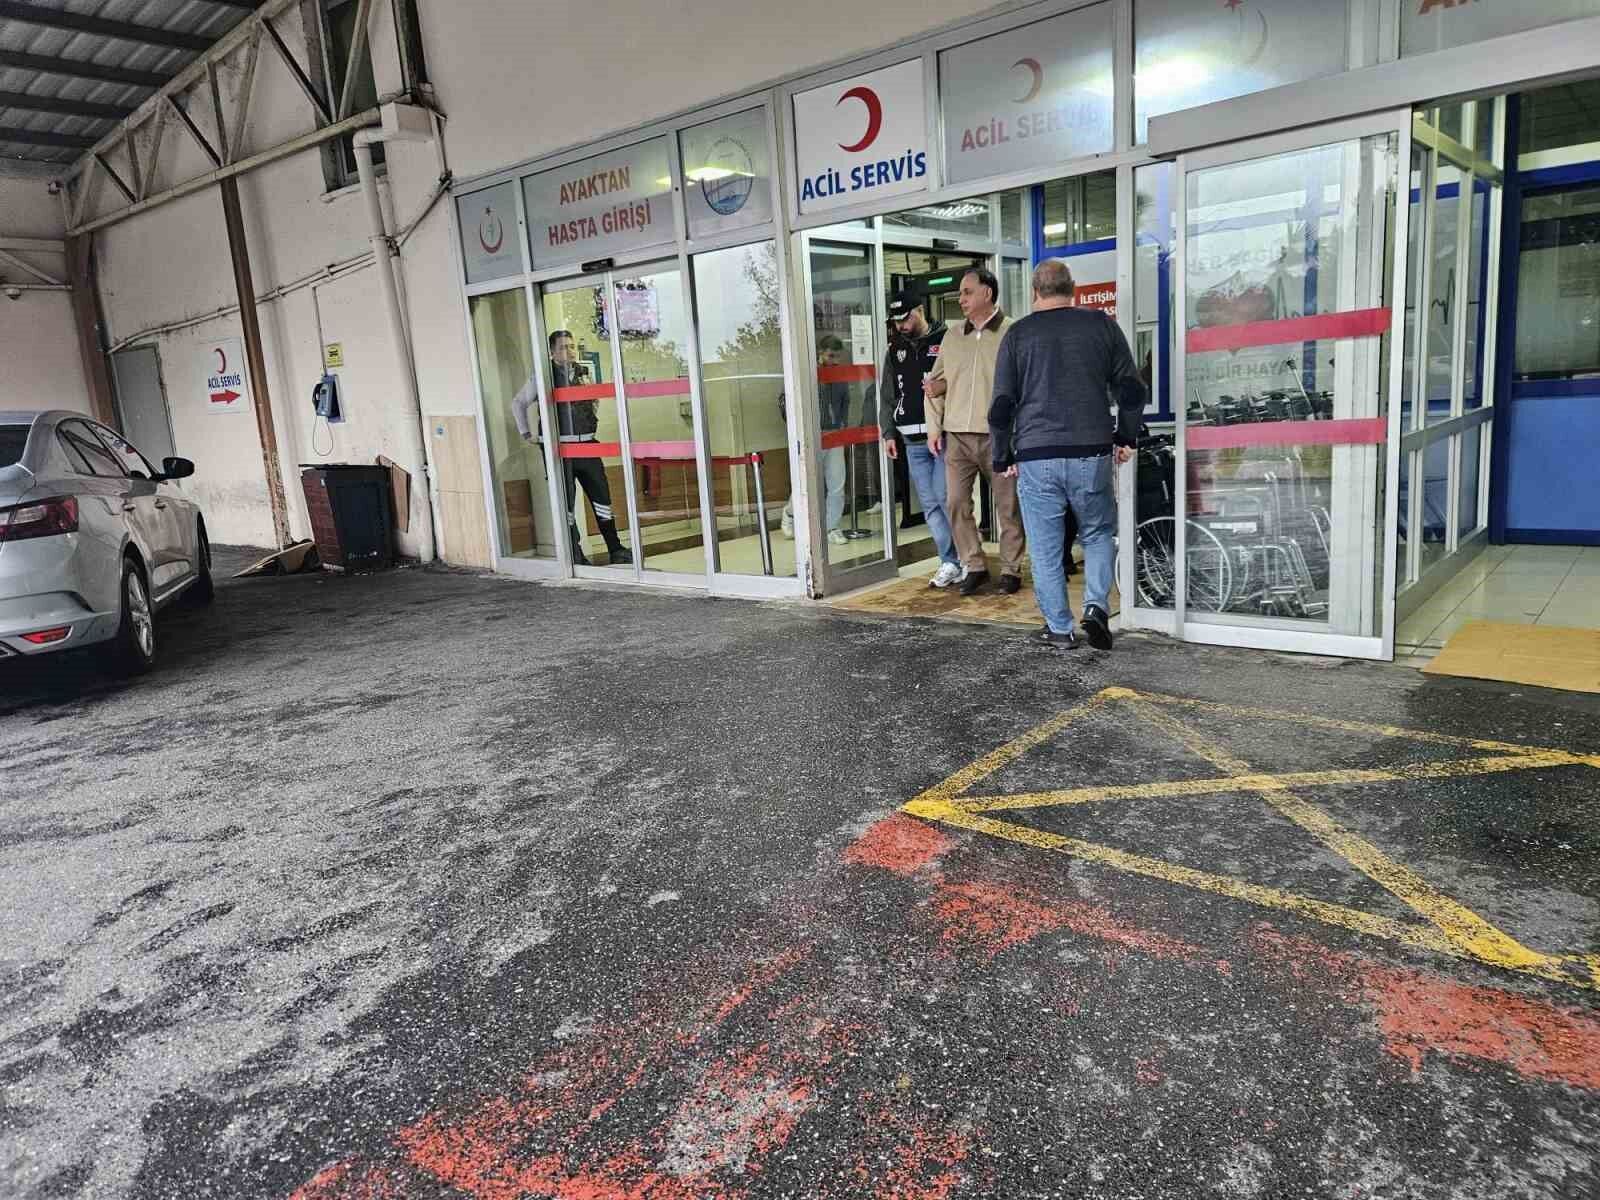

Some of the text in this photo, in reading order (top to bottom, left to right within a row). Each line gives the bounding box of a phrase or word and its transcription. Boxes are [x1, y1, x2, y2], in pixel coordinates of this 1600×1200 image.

[961, 117, 1010, 151] ACİL
[560, 166, 631, 205] AYAKTAN
[802, 148, 926, 200] ACİL SERVİS
[548, 198, 652, 246] HASTA GİRİŞİ
[220, 371, 240, 387] SERVİS
